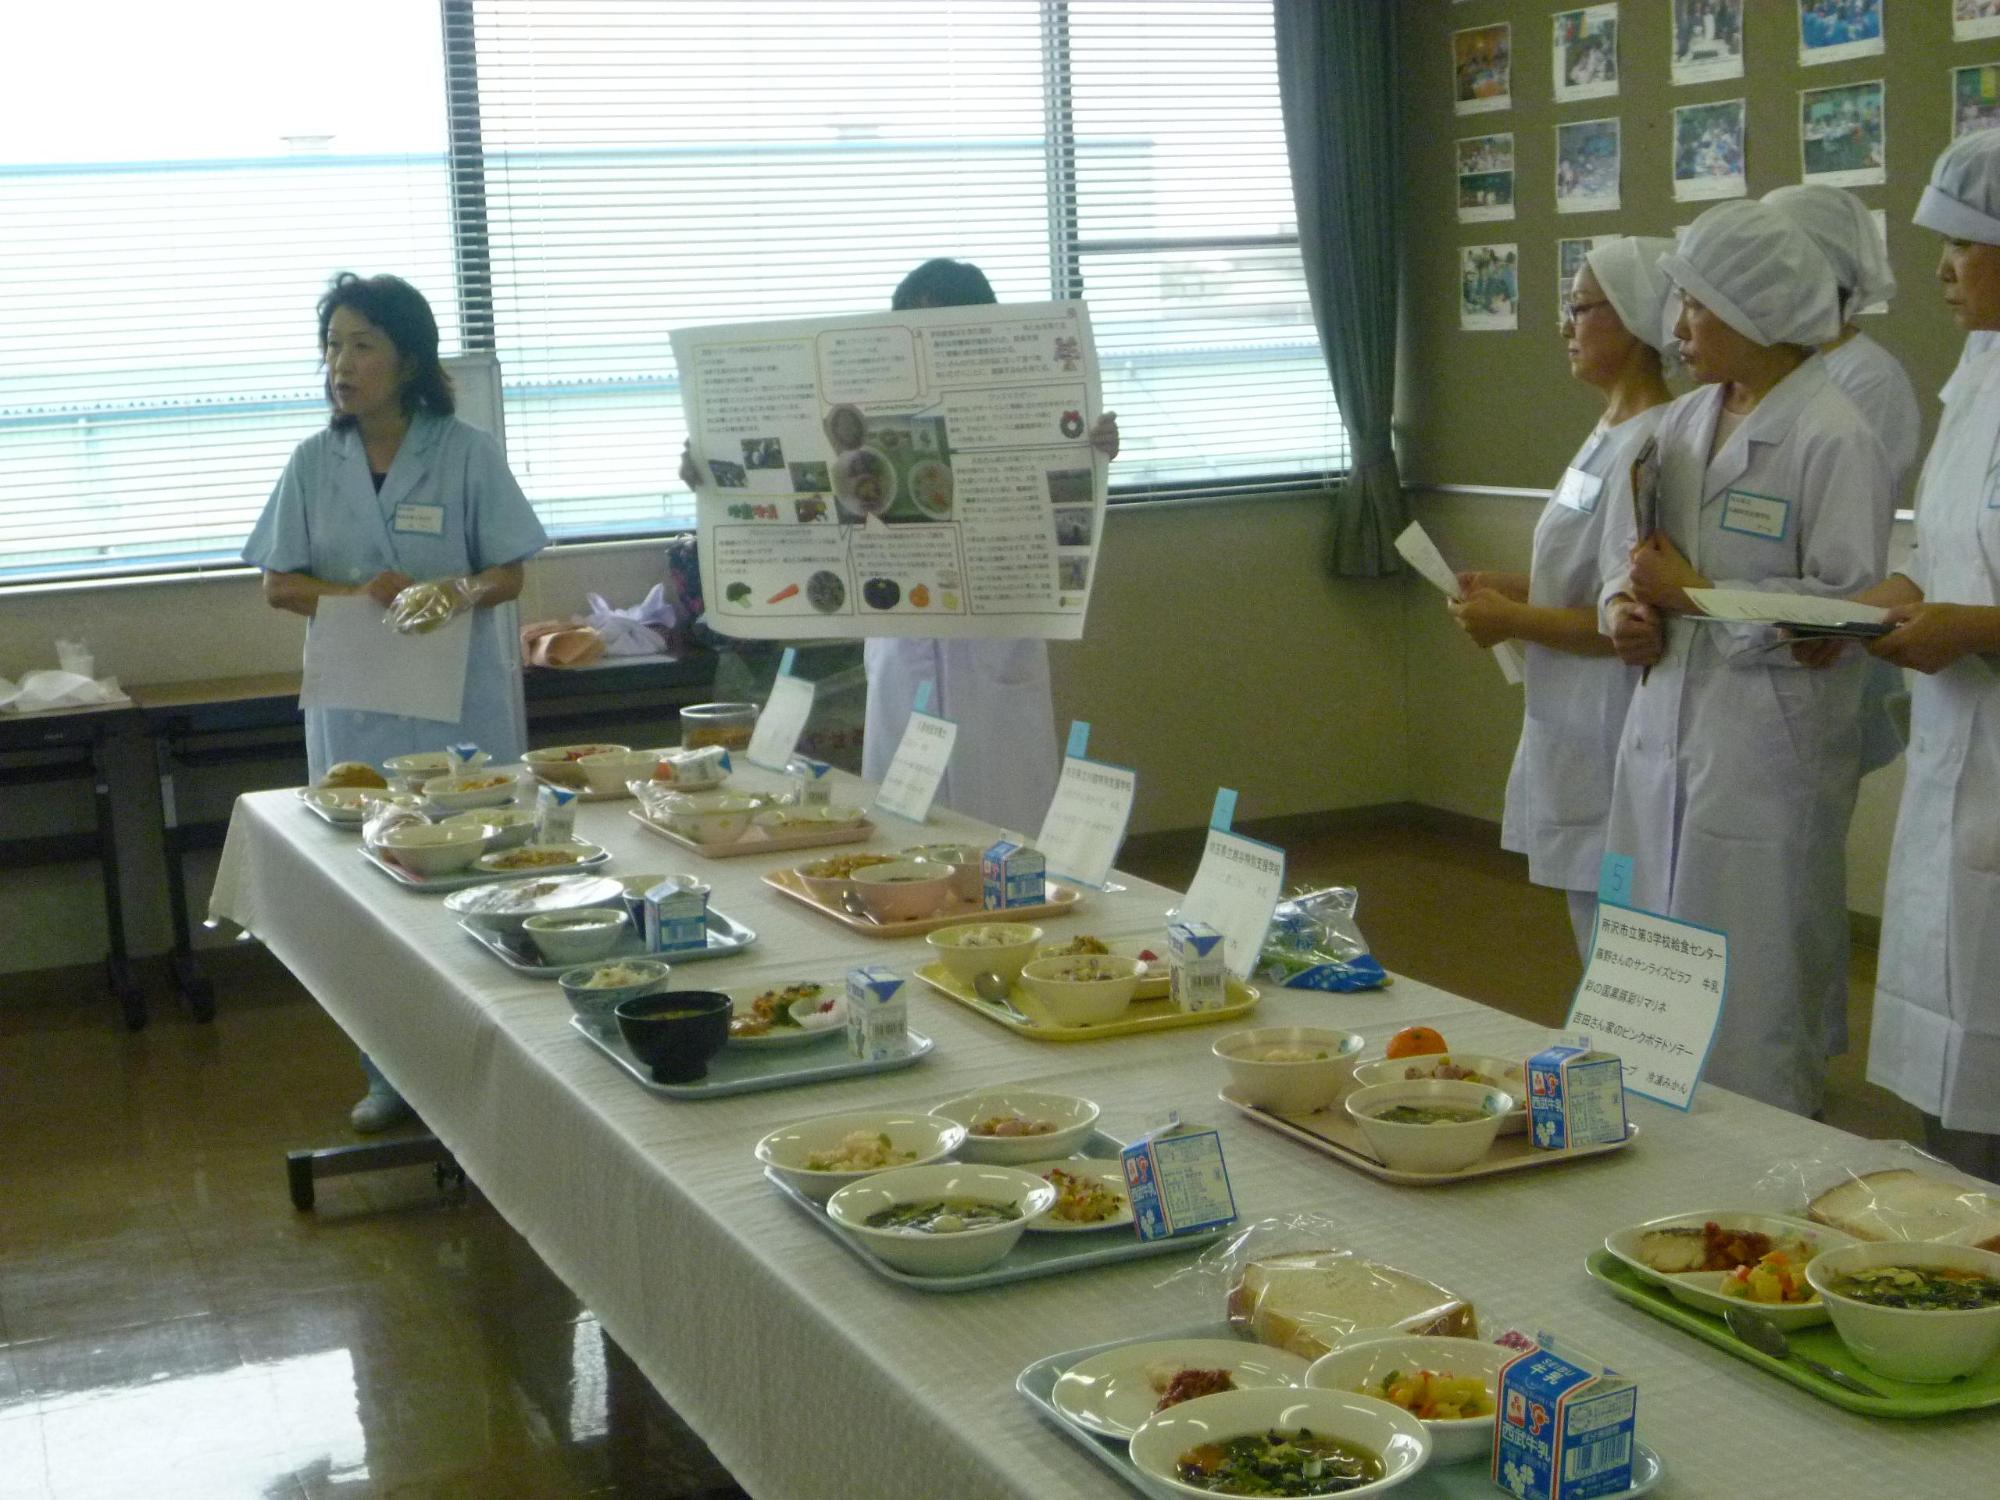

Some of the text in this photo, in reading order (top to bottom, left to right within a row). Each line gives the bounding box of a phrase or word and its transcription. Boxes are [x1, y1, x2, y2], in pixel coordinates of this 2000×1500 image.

[1611, 862, 1625, 892] 5
[1601, 917, 1723, 960] 所沢市立第3学校給食センター
